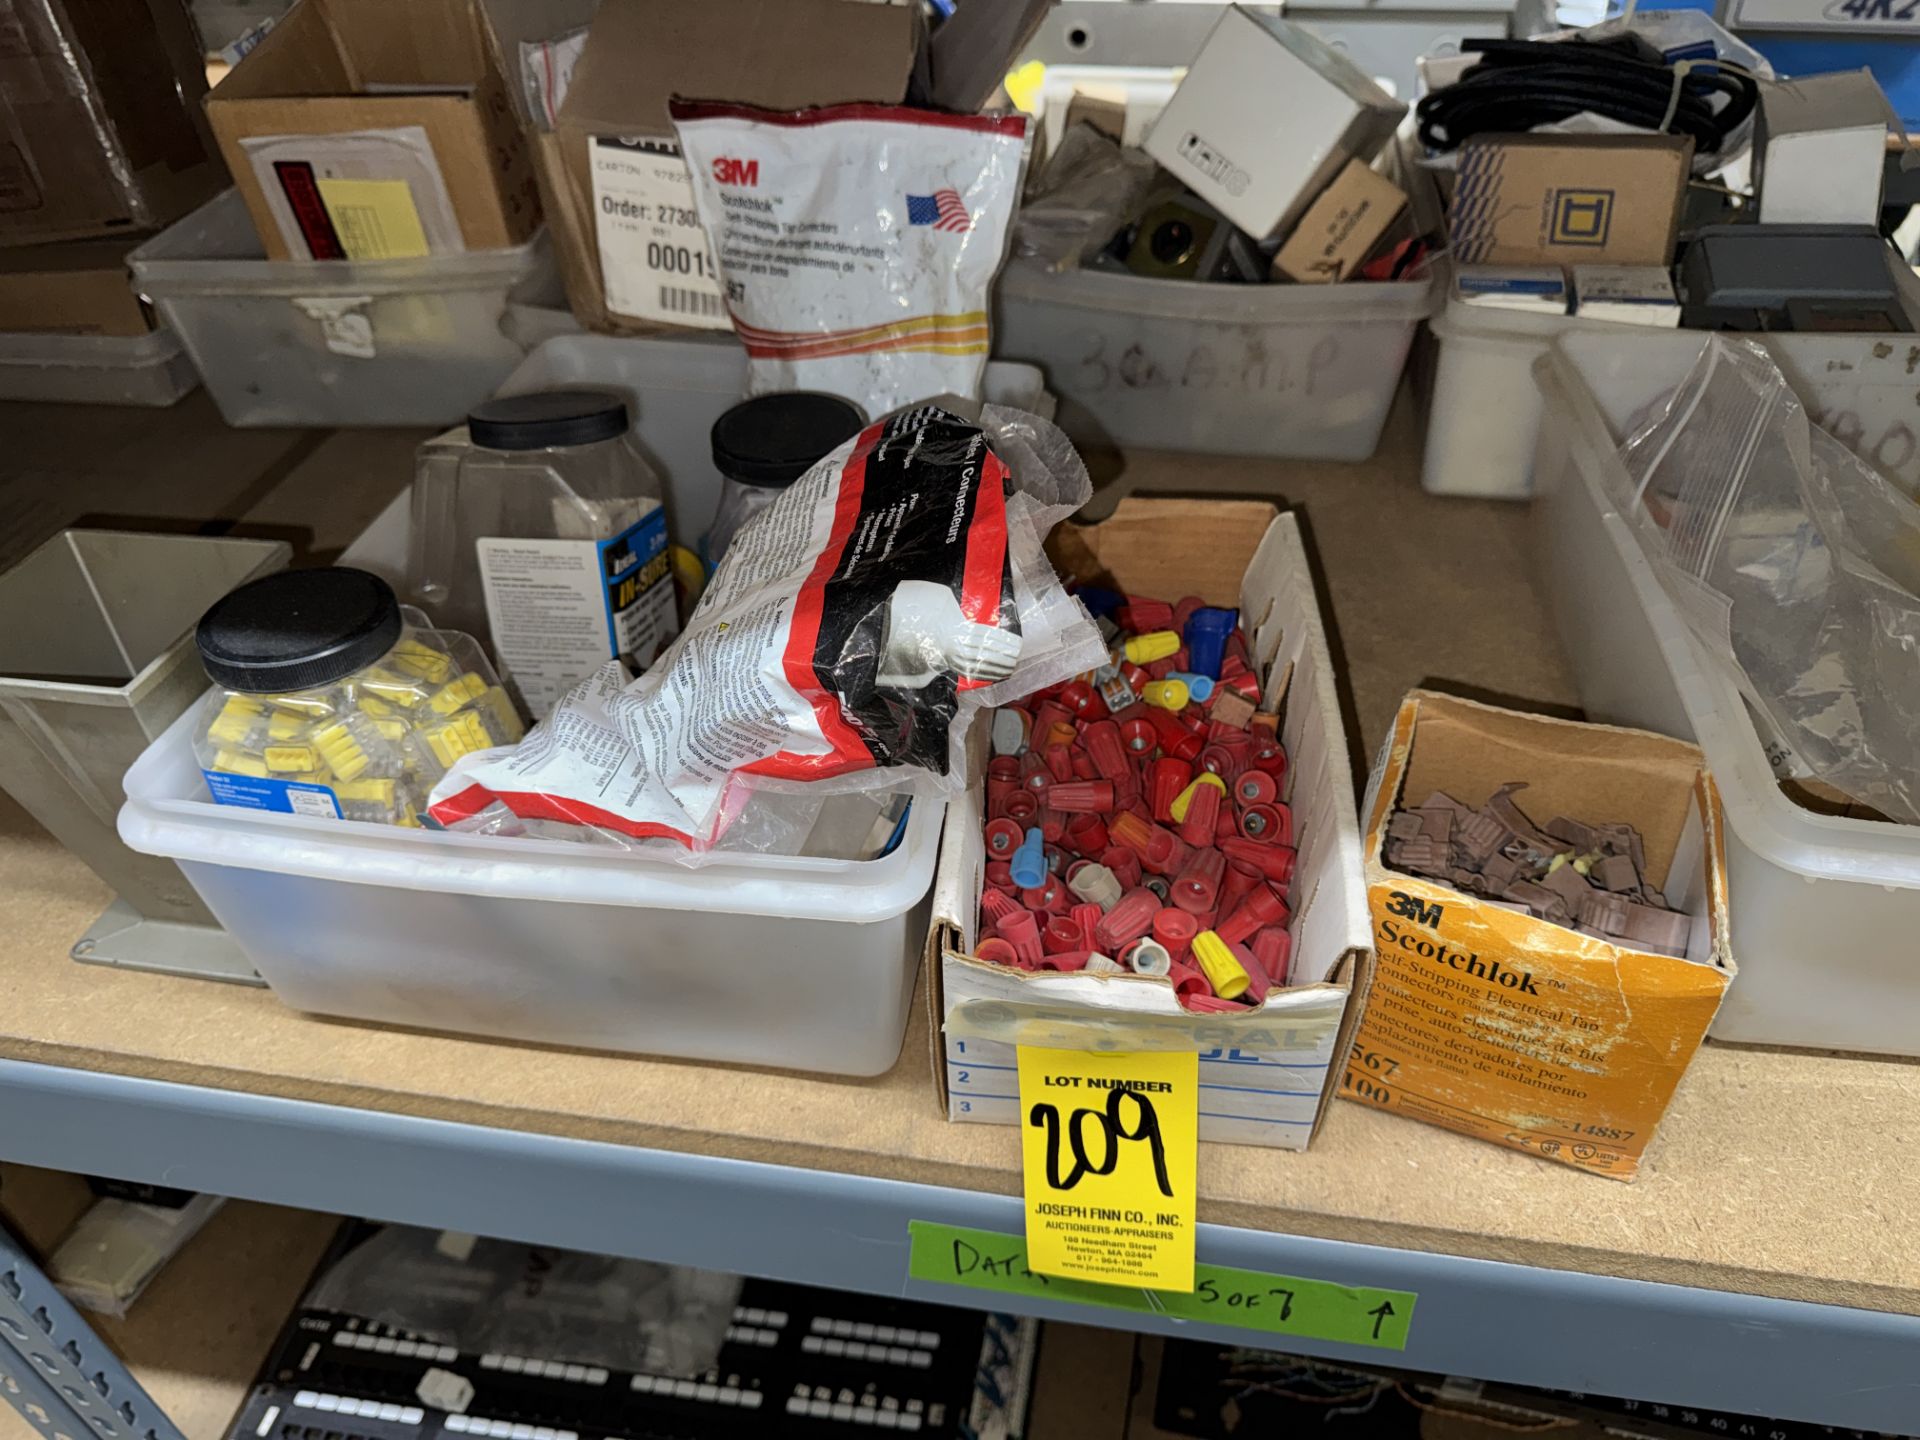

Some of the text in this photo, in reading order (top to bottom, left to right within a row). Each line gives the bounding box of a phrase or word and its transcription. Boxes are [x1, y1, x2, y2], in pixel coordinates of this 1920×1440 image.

[711, 156, 759, 187] 3M
[602, 196, 702, 229] Order: 2730
[945, 467, 974, 544] Connecteurs
[1385, 890, 1444, 930] 3M
[1377, 919, 1540, 997] Scotchlok
[1375, 963, 1455, 1002] onnectors
[1375, 977, 1457, 1020] onnecteurs
[1554, 1041, 1573, 1055] de
[1579, 1048, 1605, 1063] fils
[1383, 998, 1424, 1021] prise,
[1487, 991, 1564, 1023] Electrical
[1570, 1014, 1600, 1034] Tap
[957, 1041, 966, 1054] 1
[1349, 1042, 1400, 1076] 567
[1362, 1018, 1469, 1065] esplazamiento
[1473, 1060, 1492, 1073] de
[1496, 1068, 1588, 1100] aislamiento
[1366, 1003, 1439, 1043] onectores
[1445, 1039, 1533, 1073] derivadores
[1537, 1066, 1567, 1082] por
[957, 1071, 971, 1084] 2
[1044, 1075, 1173, 1093] LOT NUMBER
[1343, 1071, 1390, 1105] 100
[959, 1100, 971, 1113] 3
[1030, 1087, 1174, 1198] 209
[1035, 1203, 1087, 1219] JOSEPH
[1090, 1207, 1121, 1222] FINN
[1156, 1213, 1183, 1228] INC.
[1081, 1236, 1125, 1249] Needham
[1129, 1241, 1157, 1252] Street
[1107, 1248, 1123, 1257] MA
[1624, 1400, 1639, 1411] 37
[1652, 1404, 1669, 1417] 38
[1681, 1410, 1698, 1424] 39
[1710, 1417, 1728, 1431] 40
[1739, 1424, 1756, 1436] 41
